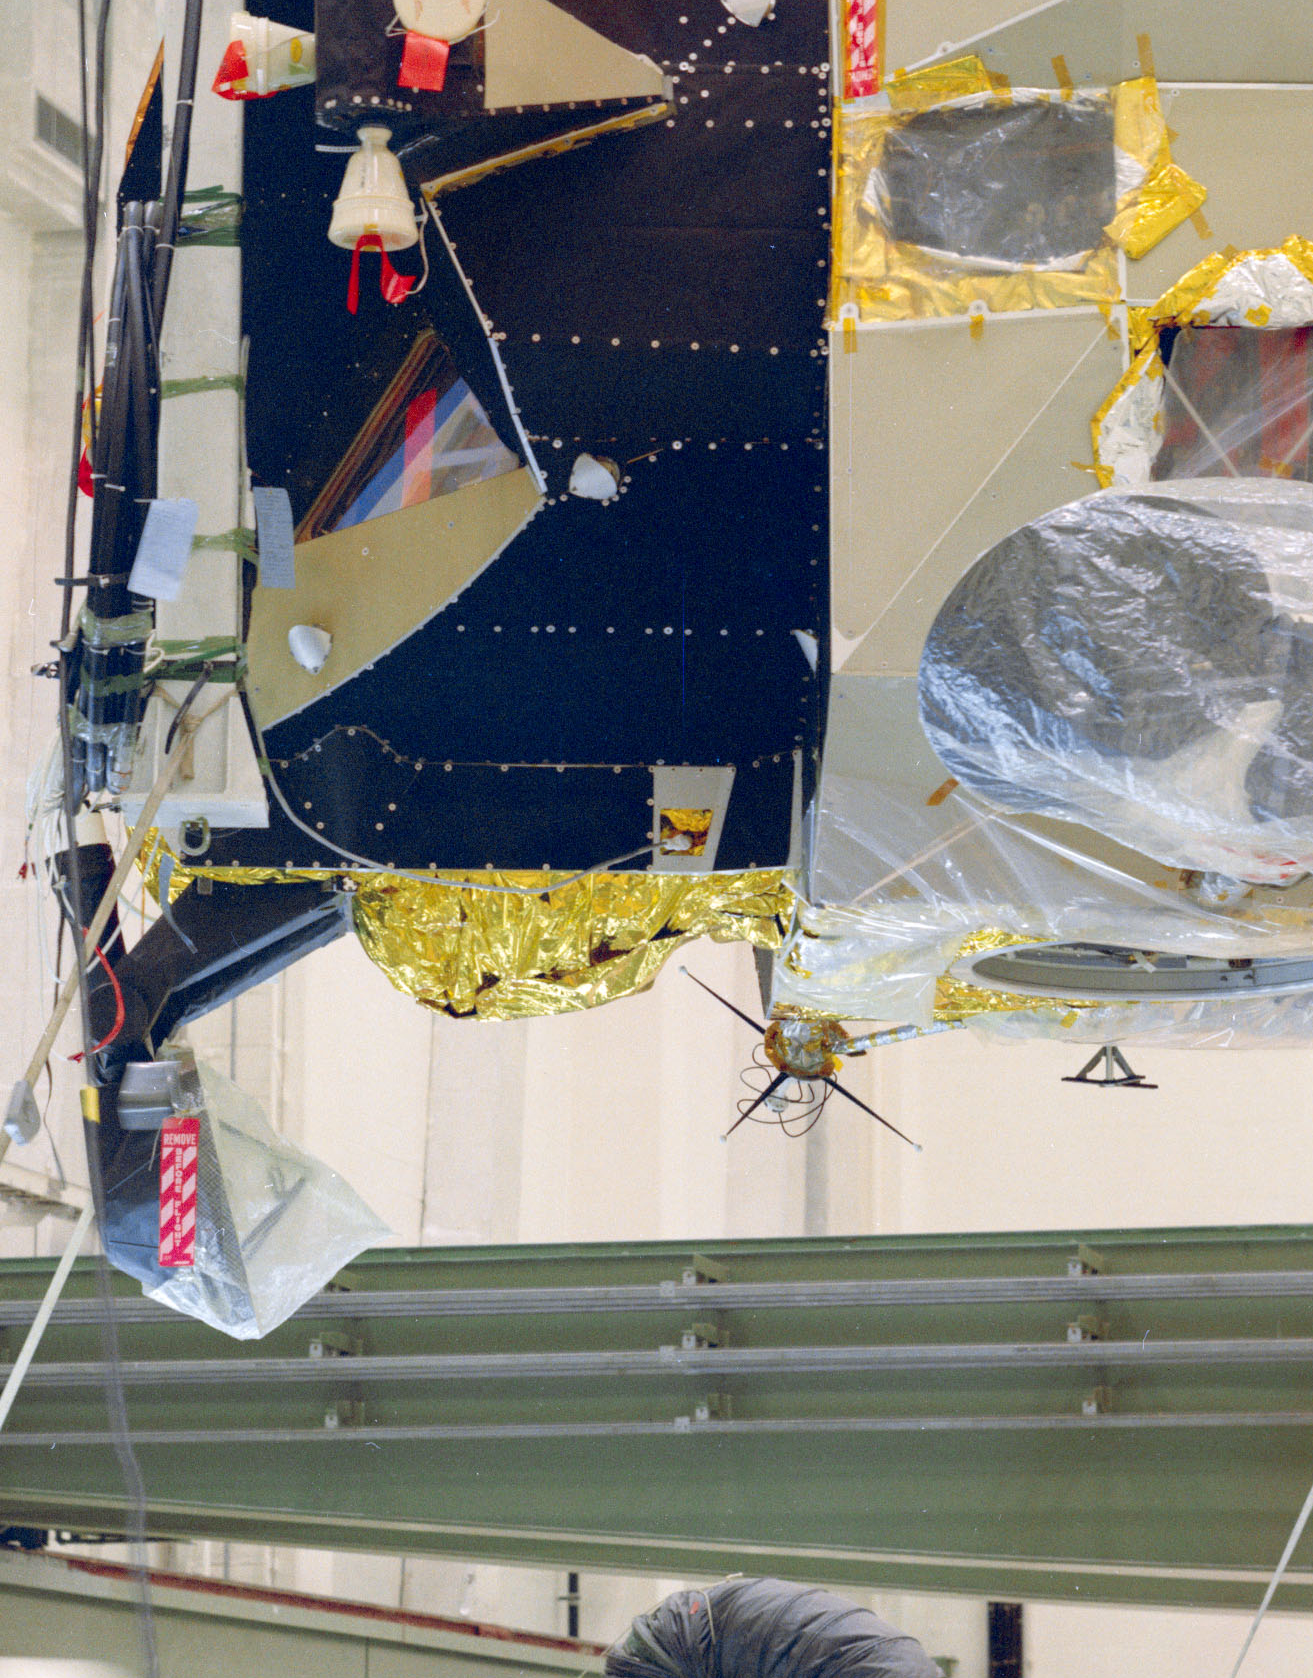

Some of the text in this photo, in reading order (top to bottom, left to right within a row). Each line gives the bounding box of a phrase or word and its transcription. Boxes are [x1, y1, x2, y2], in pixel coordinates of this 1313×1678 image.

[163, 1133, 197, 1146] REMOVE
[174, 1147, 183, 1247] BEFORE FLIGHT
